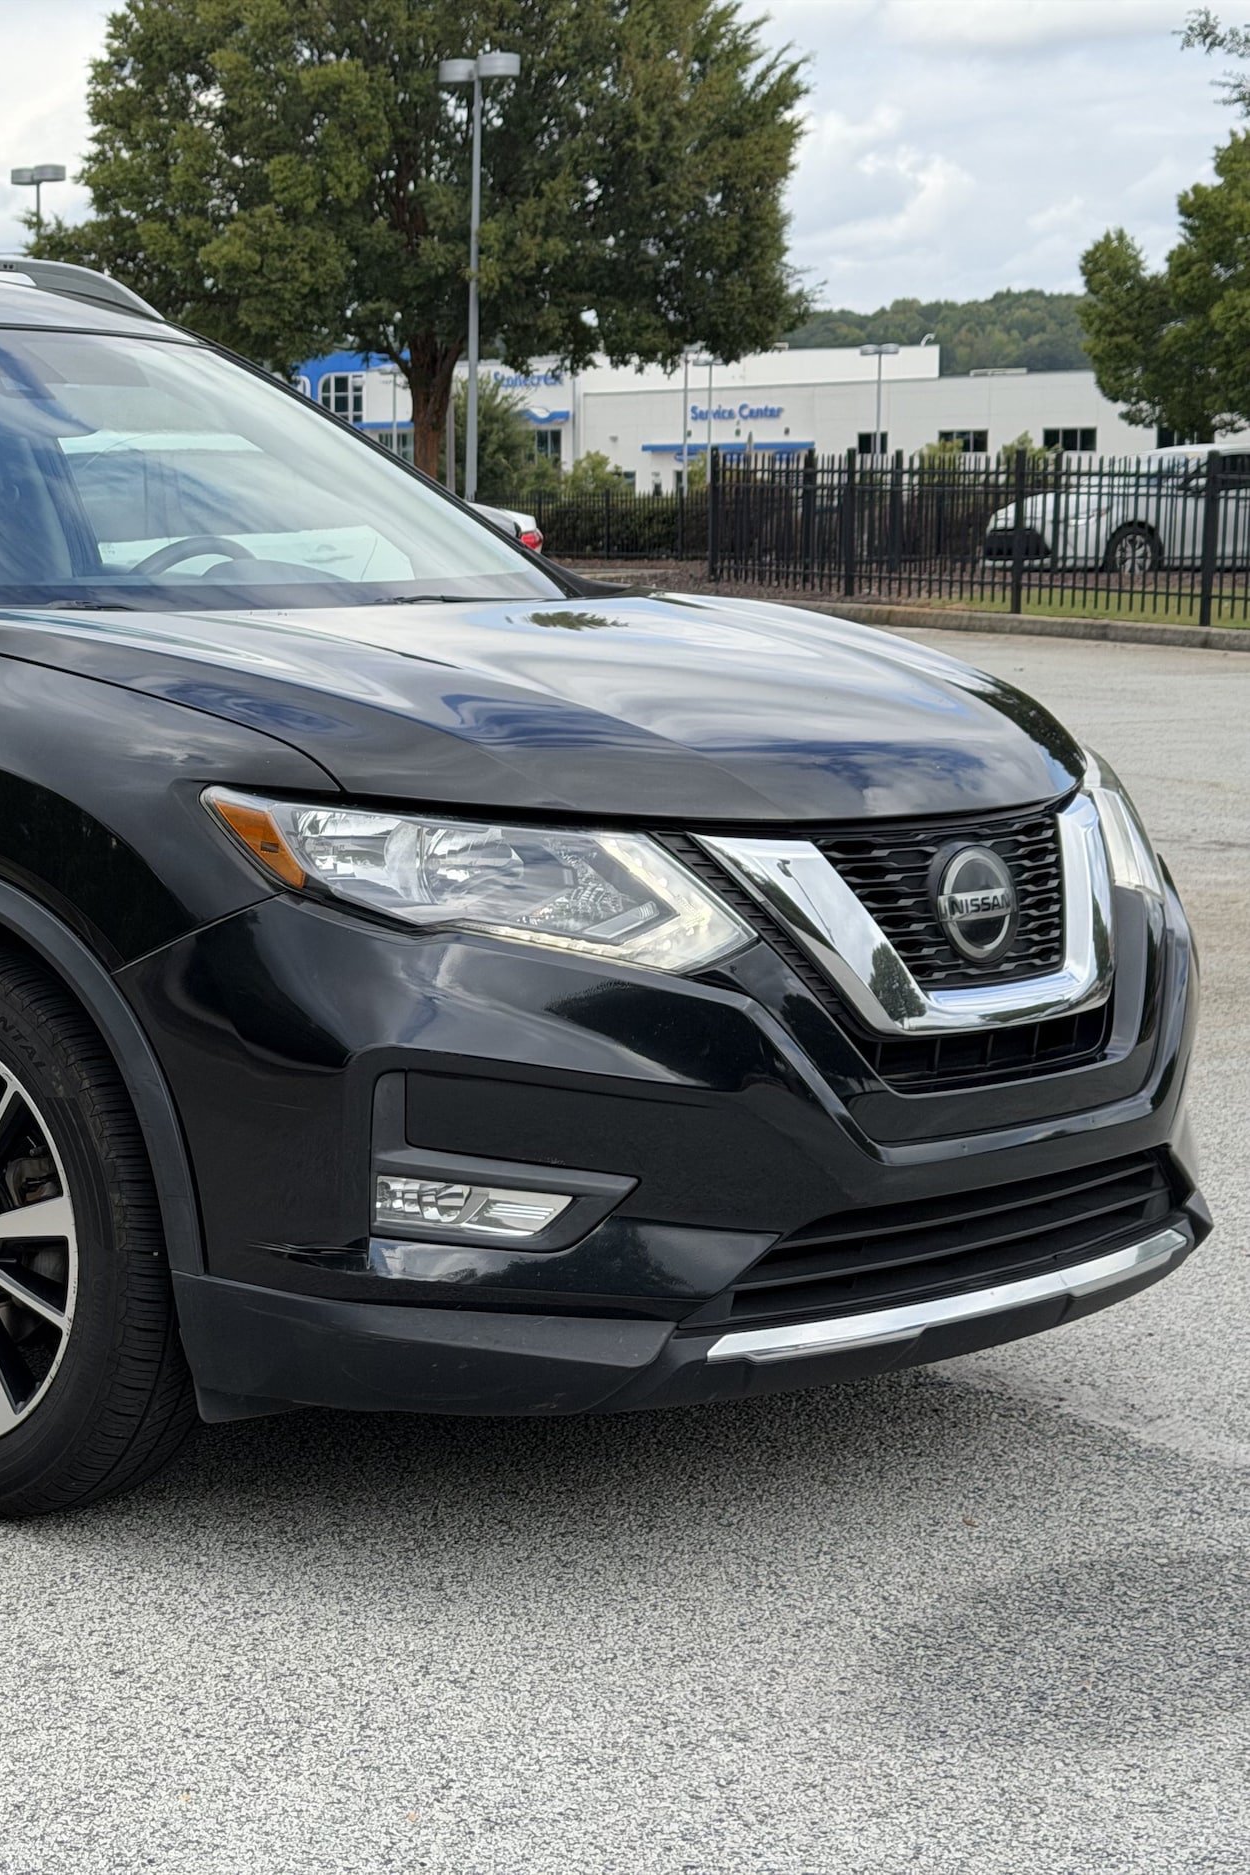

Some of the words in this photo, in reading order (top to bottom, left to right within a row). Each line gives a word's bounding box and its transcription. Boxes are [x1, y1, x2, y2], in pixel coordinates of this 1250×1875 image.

[690, 404, 736, 421] Service
[738, 402, 784, 420] Center
[948, 894, 1011, 916] NISSAN
